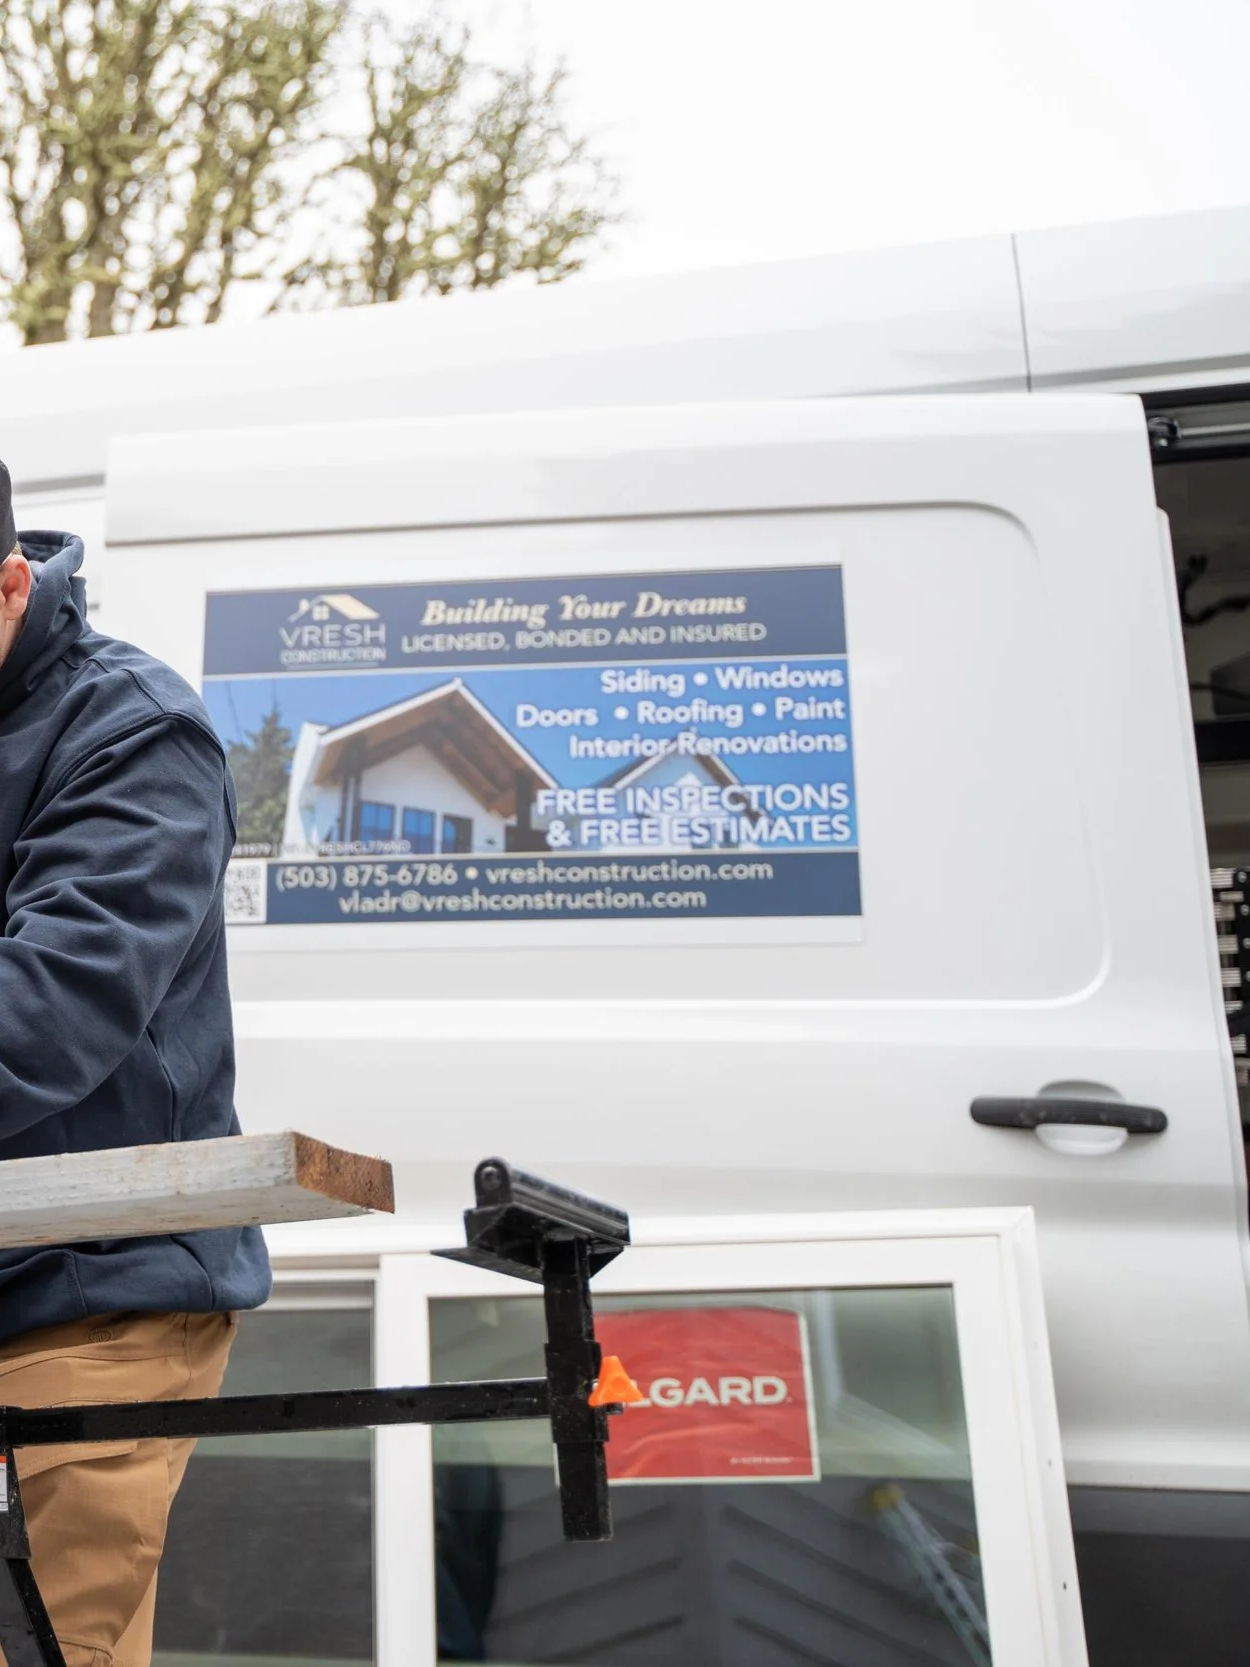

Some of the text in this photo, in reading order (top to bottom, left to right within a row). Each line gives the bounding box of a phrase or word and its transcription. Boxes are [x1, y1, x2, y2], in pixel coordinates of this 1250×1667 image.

[420, 592, 747, 630] Building Your Dreams
[279, 623, 387, 649] VRESH
[401, 623, 768, 654] LICENSED, BONDED AND INSURED
[280, 645, 387, 665] CONSTRUCTION
[600, 664, 844, 697] Siding Windows
[516, 697, 847, 728] Doors Roofing Paint
[569, 730, 848, 759] Interior Renovations
[537, 783, 850, 816] FREE INSPECTIONS
[545, 813, 851, 848] & FREE ESTIMATES
[275, 858, 774, 892] (503) 875-6786 vreshconstruction.com
[338, 886, 708, 914] vladr@vreshconstruction.com
